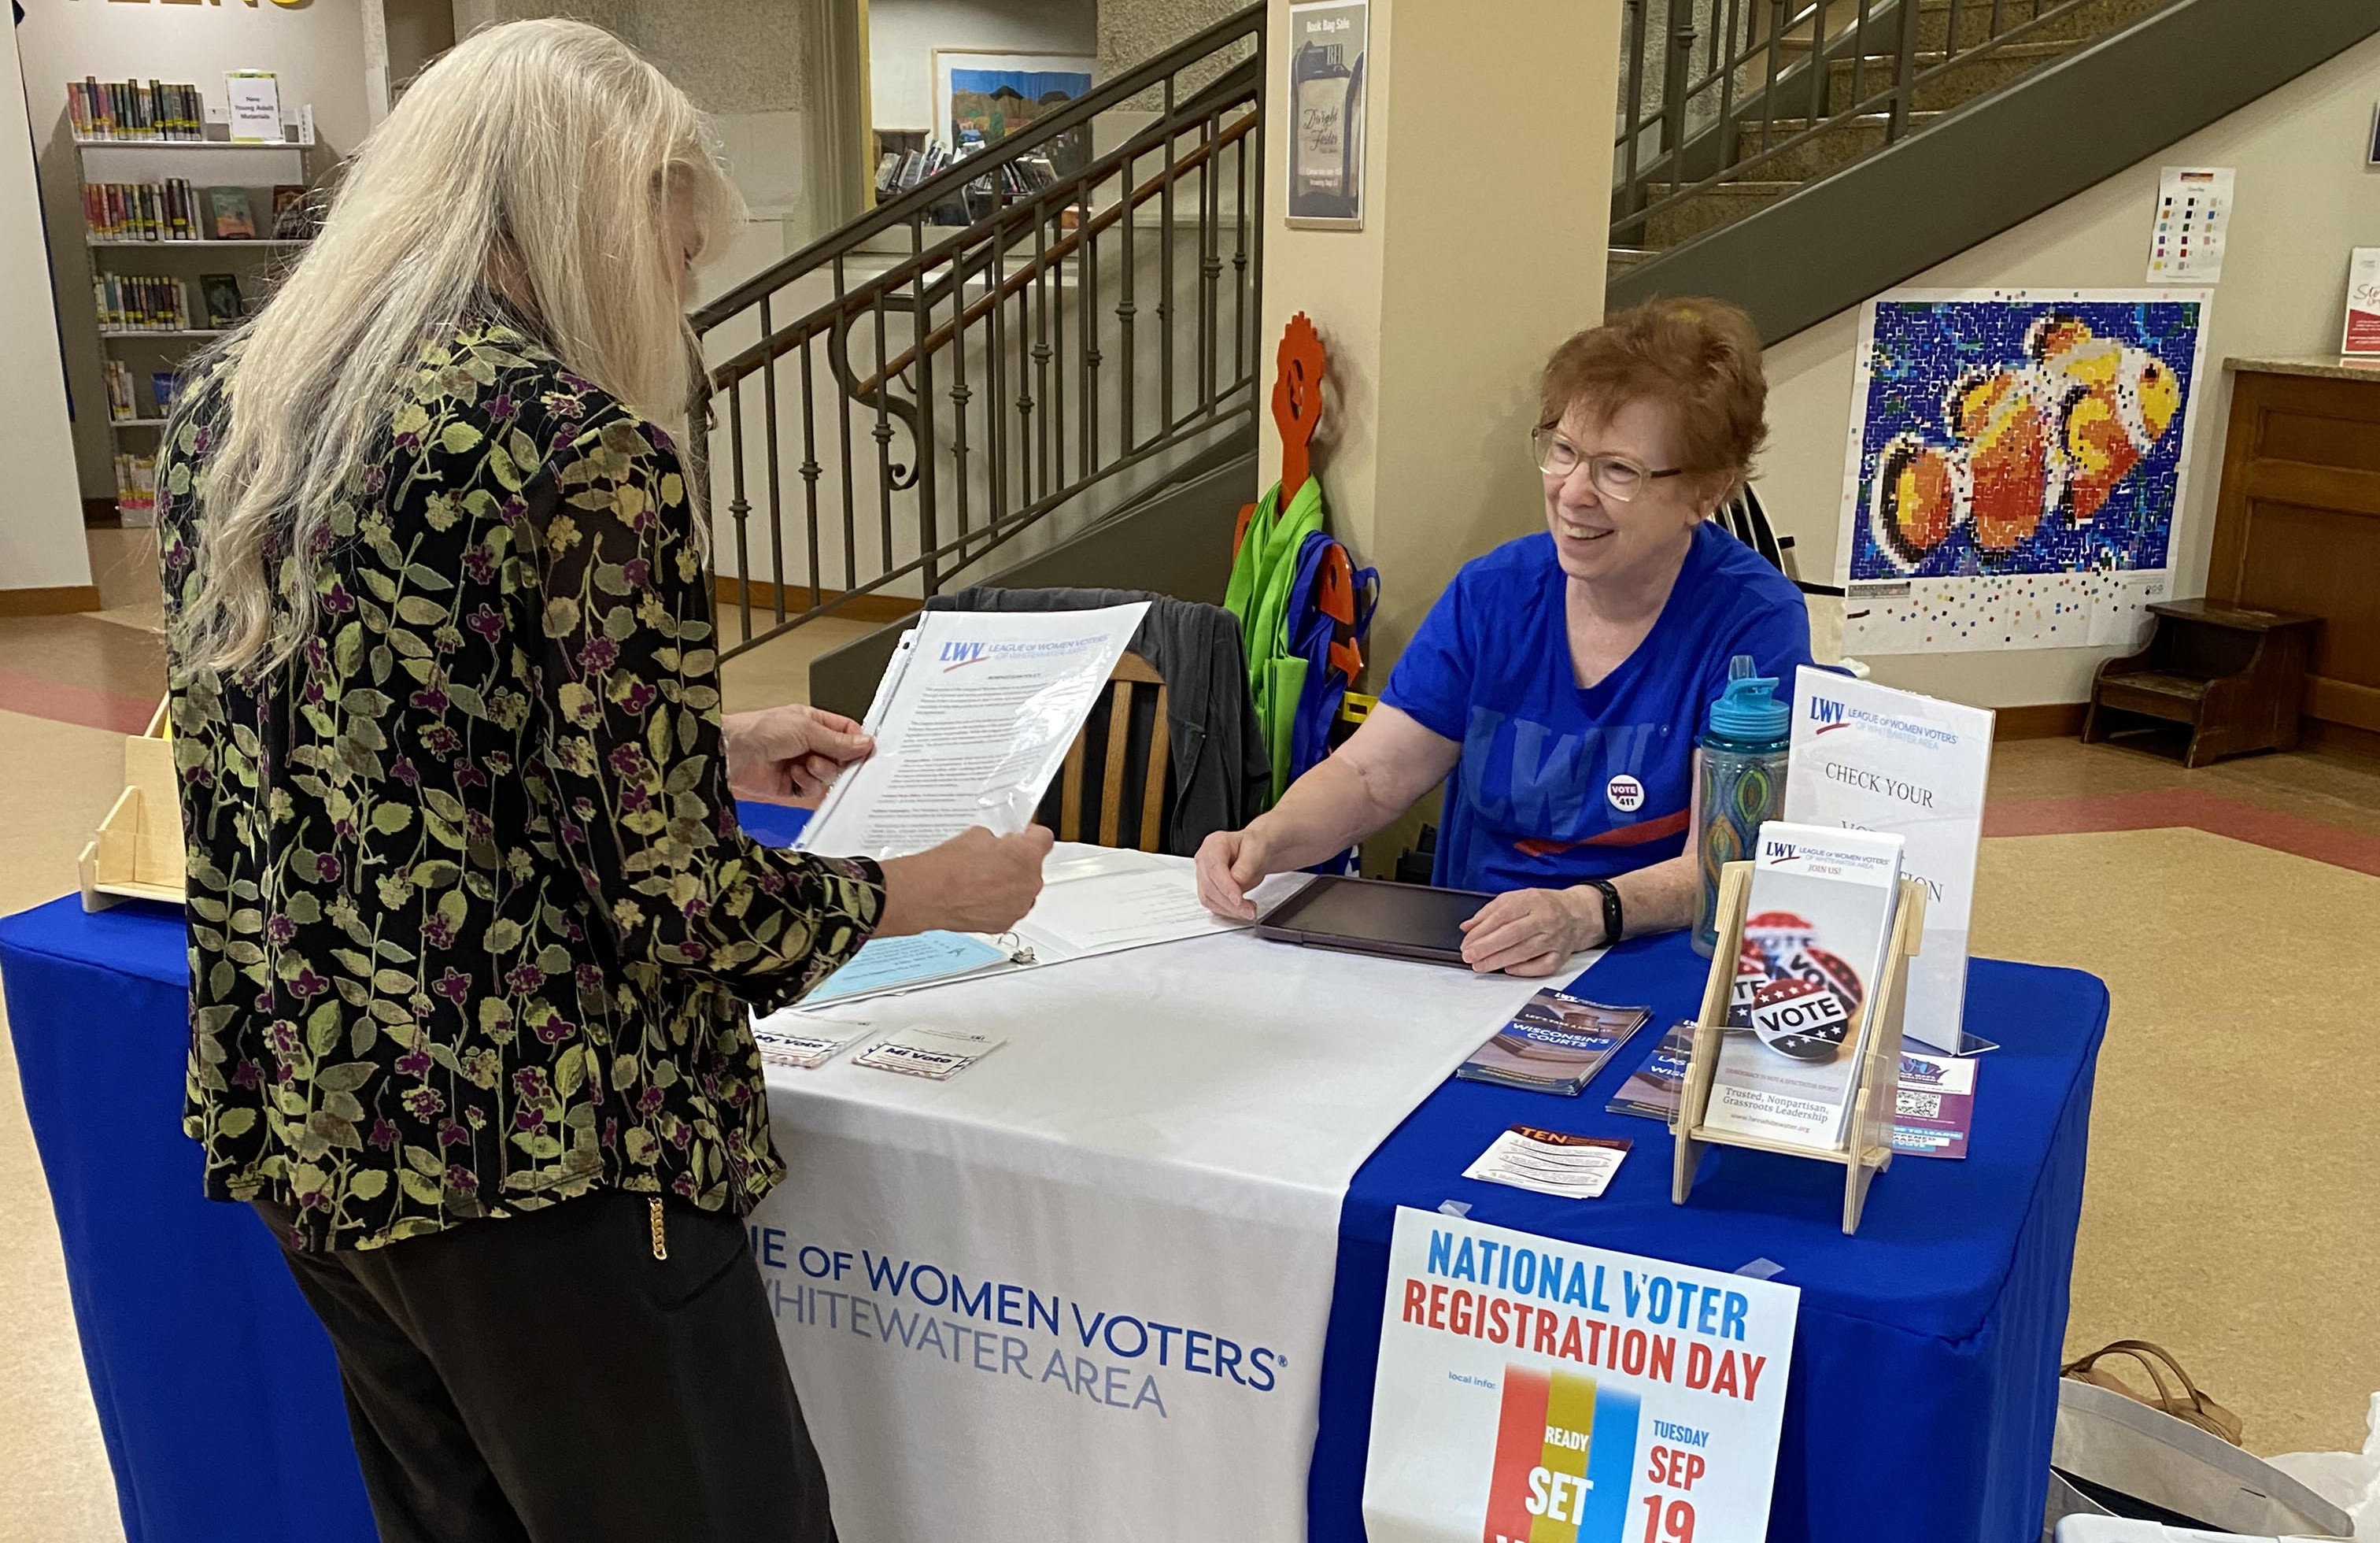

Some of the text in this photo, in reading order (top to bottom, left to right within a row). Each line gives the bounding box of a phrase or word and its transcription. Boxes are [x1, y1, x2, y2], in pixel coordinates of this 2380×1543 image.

[939, 642, 986, 661] LWV
[989, 643, 1023, 653] LEAGUE
[1810, 696, 1845, 723] LWV
[1848, 708, 1879, 724] LEAGUE
[1879, 717, 1890, 726] OF
[1890, 720, 1924, 736] WOMEN
[1611, 785, 1637, 796] VOTE
[1825, 762, 1934, 809] CHECK YOUR
[1620, 797, 1635, 806] 411
[1766, 841, 1796, 857] LWV
[1799, 847, 1824, 856] LEAGUE
[1834, 850, 1862, 862] WOMEN
[1808, 864, 1827, 874] JOIN
[1758, 997, 1842, 1032] VOTE
[1513, 1023, 1610, 1045] WISCONSIN'S
[1527, 1033, 1588, 1047] COURTS
[1725, 1087, 1765, 1102] Trusted,
[1723, 1096, 1828, 1123] Grassroots Leadership
[1521, 1127, 1569, 1144] TEN
[799, 1245, 853, 1282] OF
[862, 1249, 1060, 1337] WOMEN
[1427, 1229, 1750, 1342] NATIONAL VOTER
[765, 1278, 1167, 1419] HITEWATER AREA
[1401, 1278, 1767, 1401] REGISTRATION DAY
[1448, 1371, 1496, 1389] local info:
[1544, 1425, 1590, 1452] READY
[1653, 1419, 1709, 1449] TUESDAY
[1647, 1445, 1706, 1493] SEP
[1524, 1466, 1594, 1526] SET
[1643, 1494, 1695, 1543] 19
